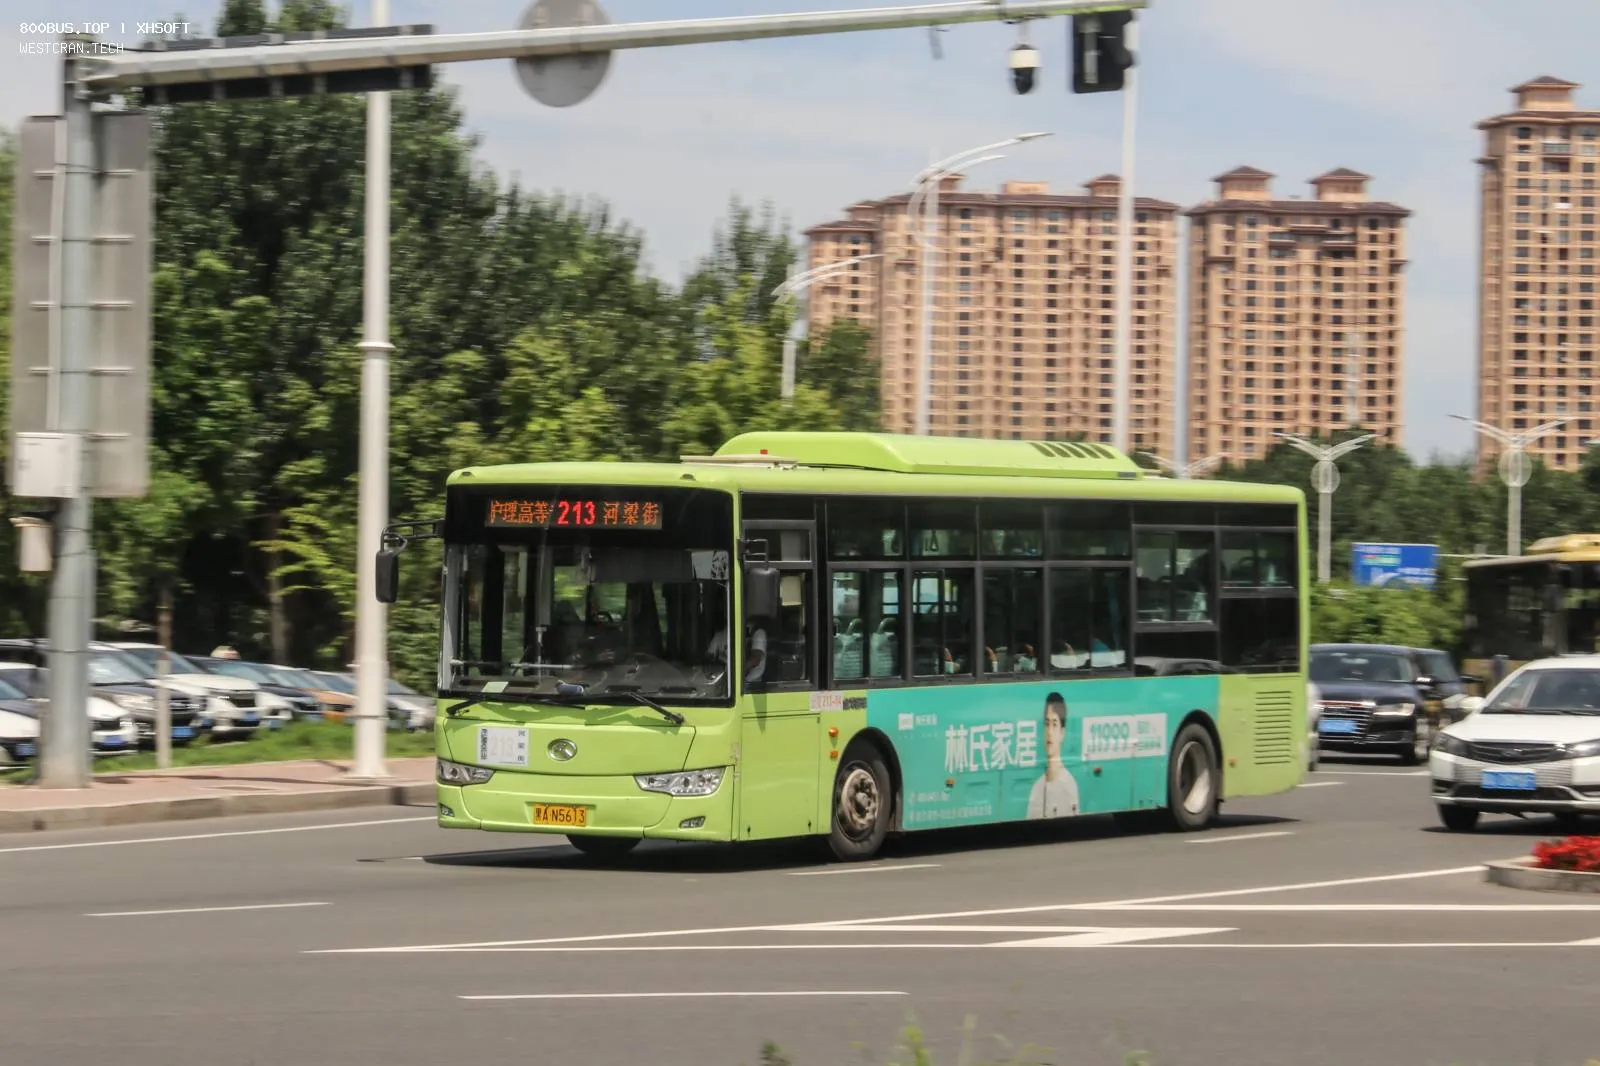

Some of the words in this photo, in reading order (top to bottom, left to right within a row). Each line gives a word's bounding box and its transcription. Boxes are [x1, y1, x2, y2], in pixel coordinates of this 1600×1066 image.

[557, 501, 597, 525] 213
[603, 502, 659, 525] 河梁街
[944, 719, 1038, 773] 林氏家居
